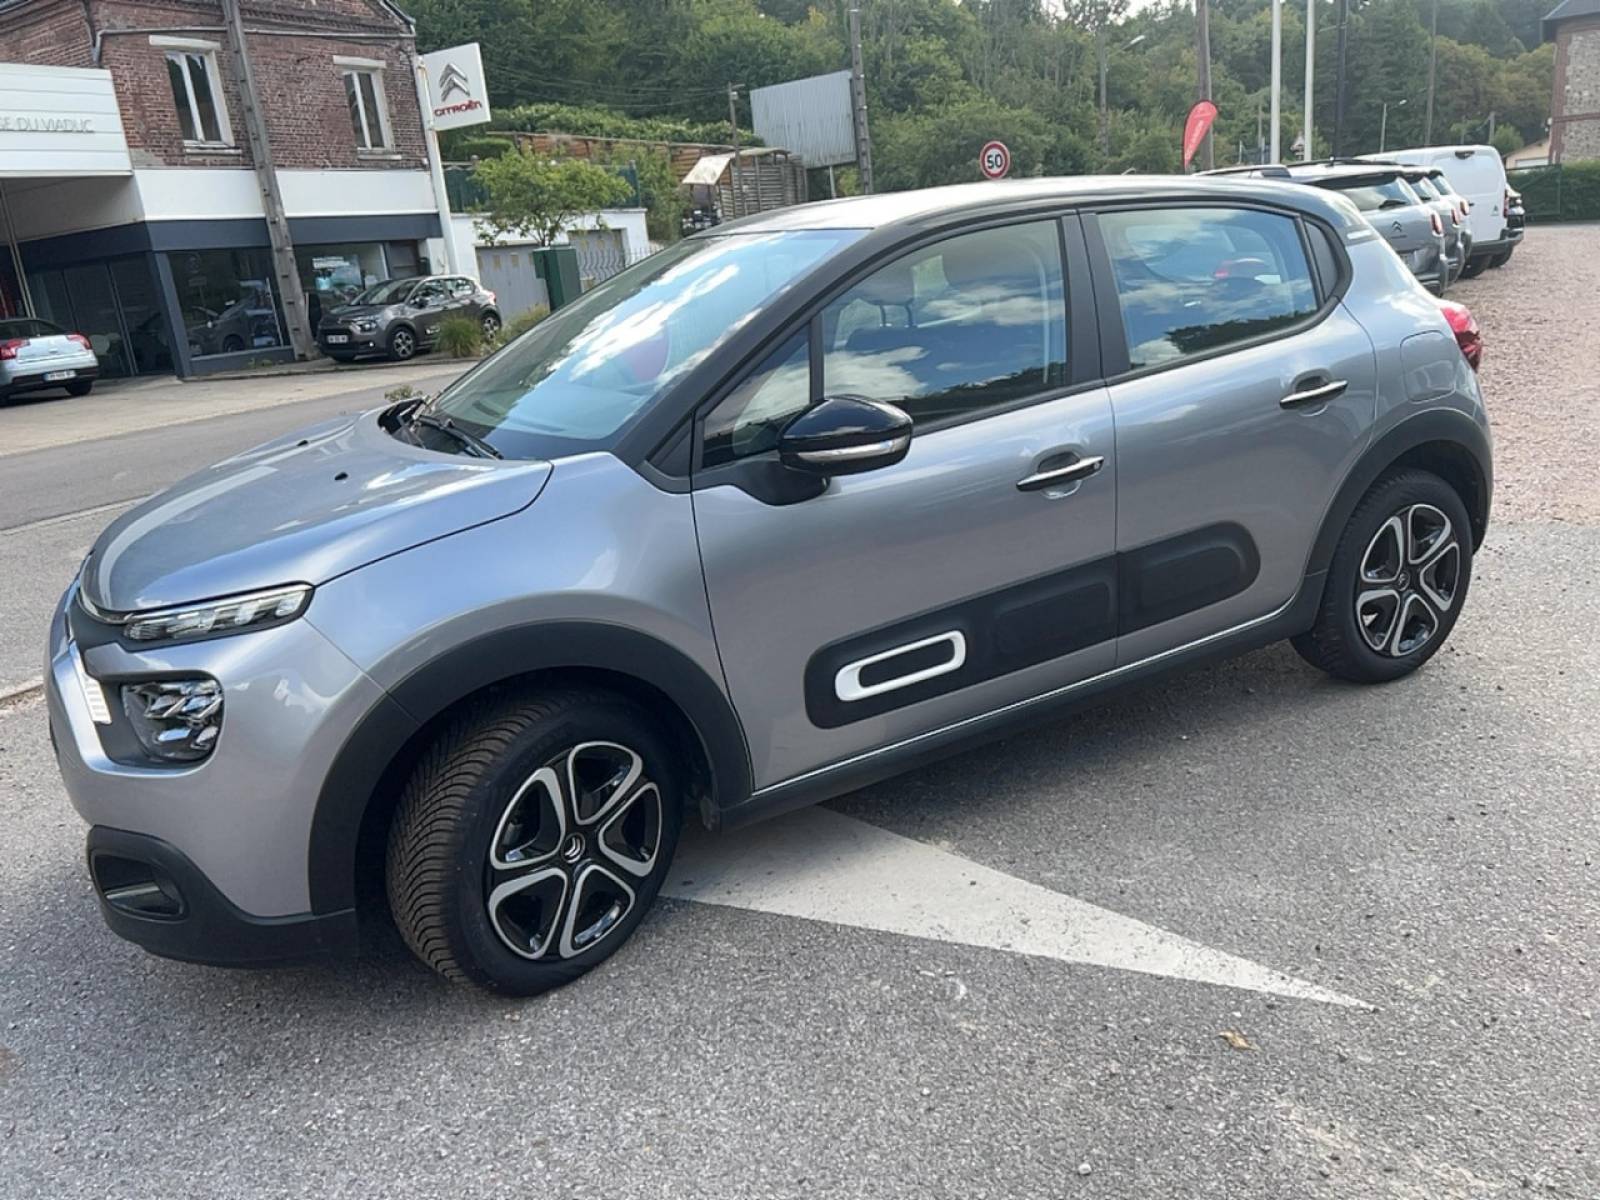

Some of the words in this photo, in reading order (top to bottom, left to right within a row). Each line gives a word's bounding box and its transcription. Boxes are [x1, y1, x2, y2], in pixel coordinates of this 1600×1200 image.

[16, 117, 39, 132] DU
[40, 118, 95, 133] VIADUC
[987, 153, 1003, 169] 50
